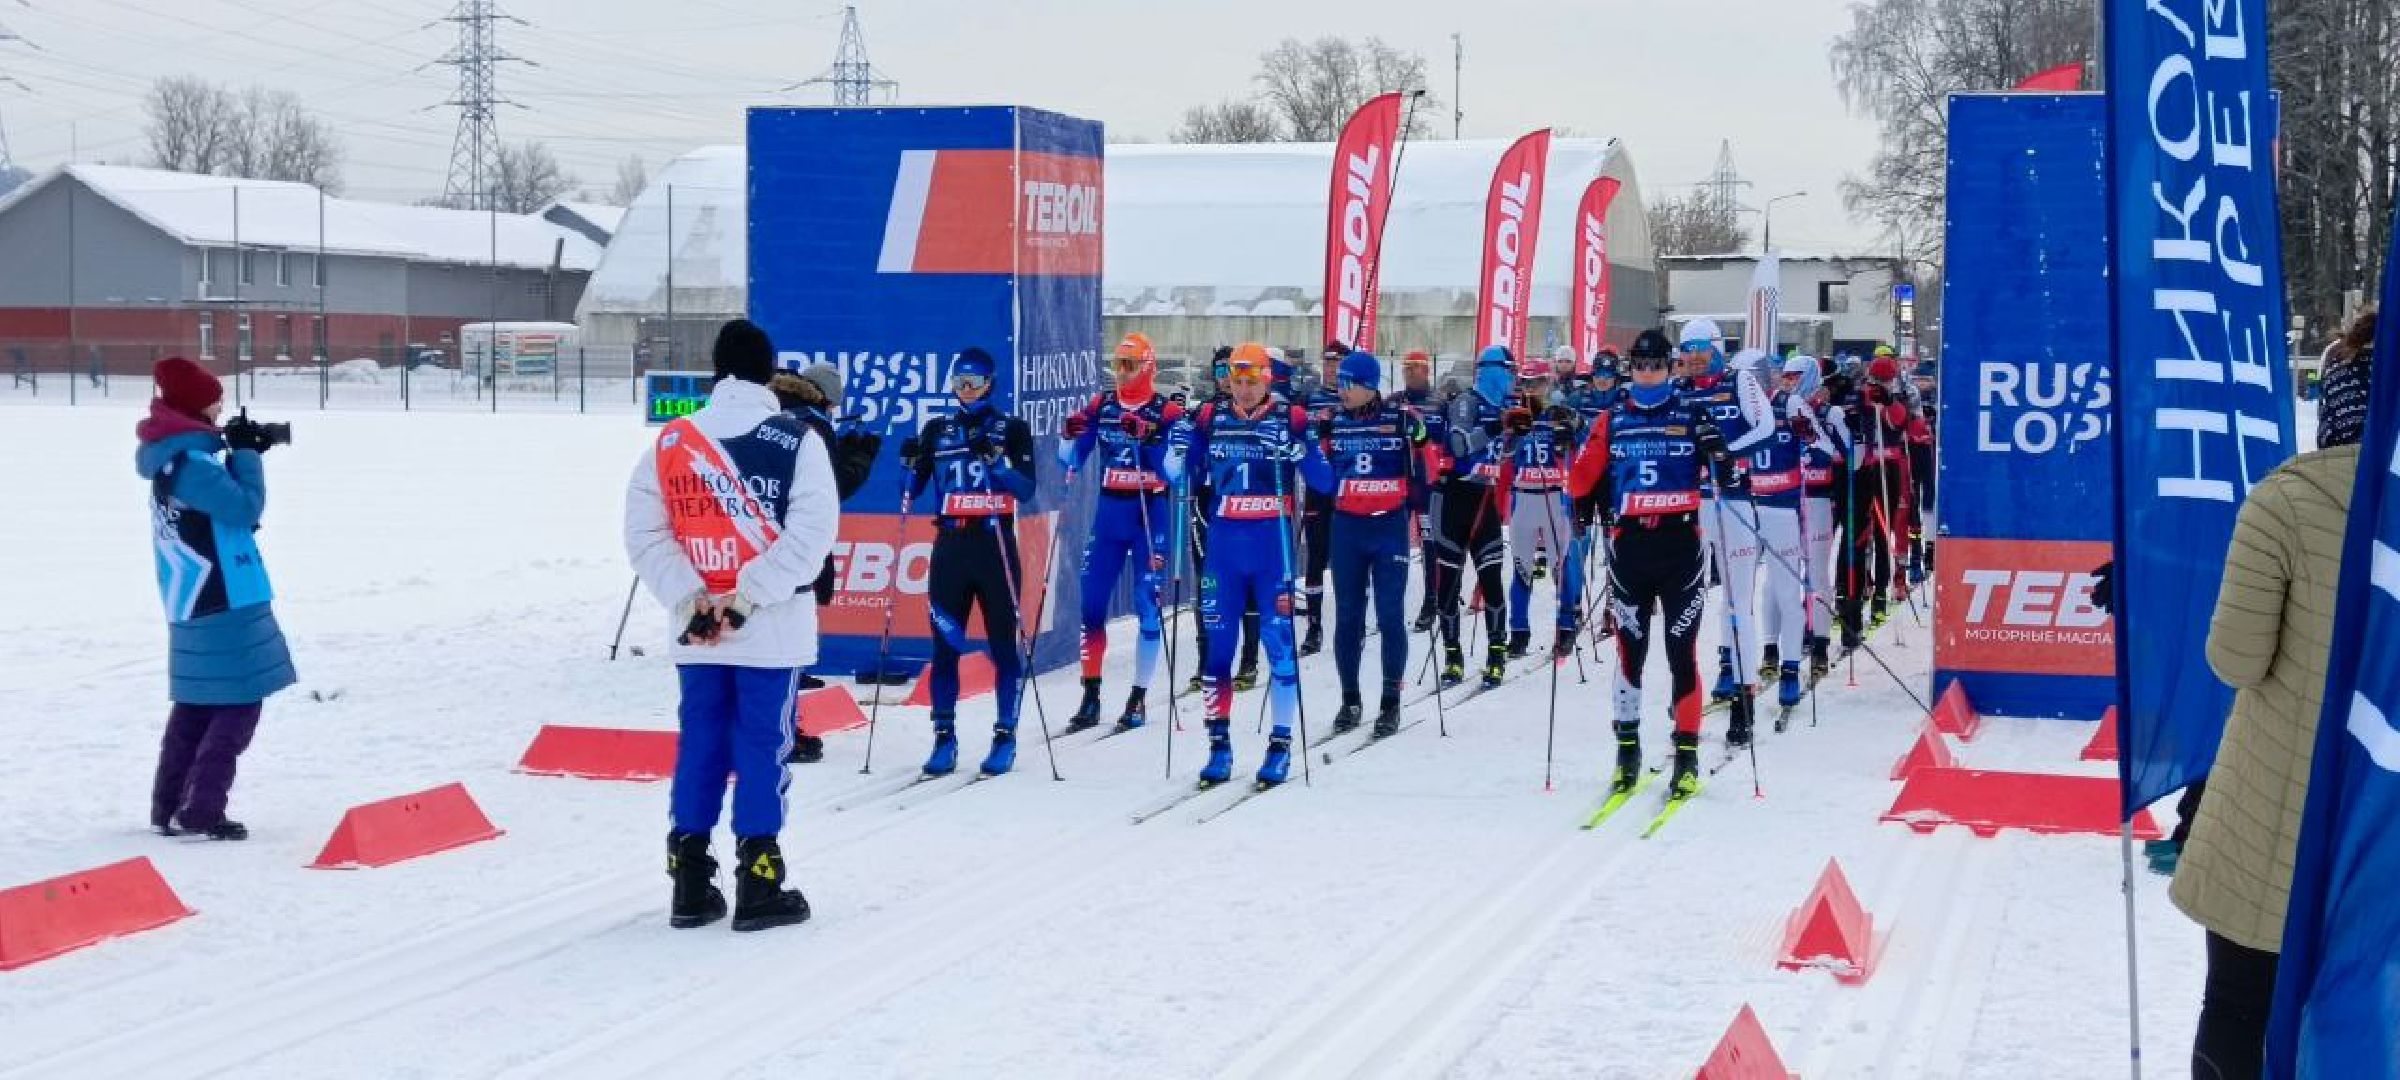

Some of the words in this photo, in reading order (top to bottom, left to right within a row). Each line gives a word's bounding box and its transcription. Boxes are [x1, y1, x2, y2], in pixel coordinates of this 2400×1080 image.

[1025, 181, 1097, 234] TEBOIL
[1978, 411, 2112, 454] LOP
[1114, 447, 1133, 466] 4
[1355, 453, 1373, 475] 8
[949, 460, 985, 488] 19
[1236, 463, 1249, 490] 1
[1639, 460, 1658, 486] 5
[1635, 494, 1692, 509] TEBOIL
[685, 537, 739, 571] ДЬЯ
[1965, 627, 2056, 643] МОТОРНЫЕ
[2057, 631, 2115, 645] МАСЛА
